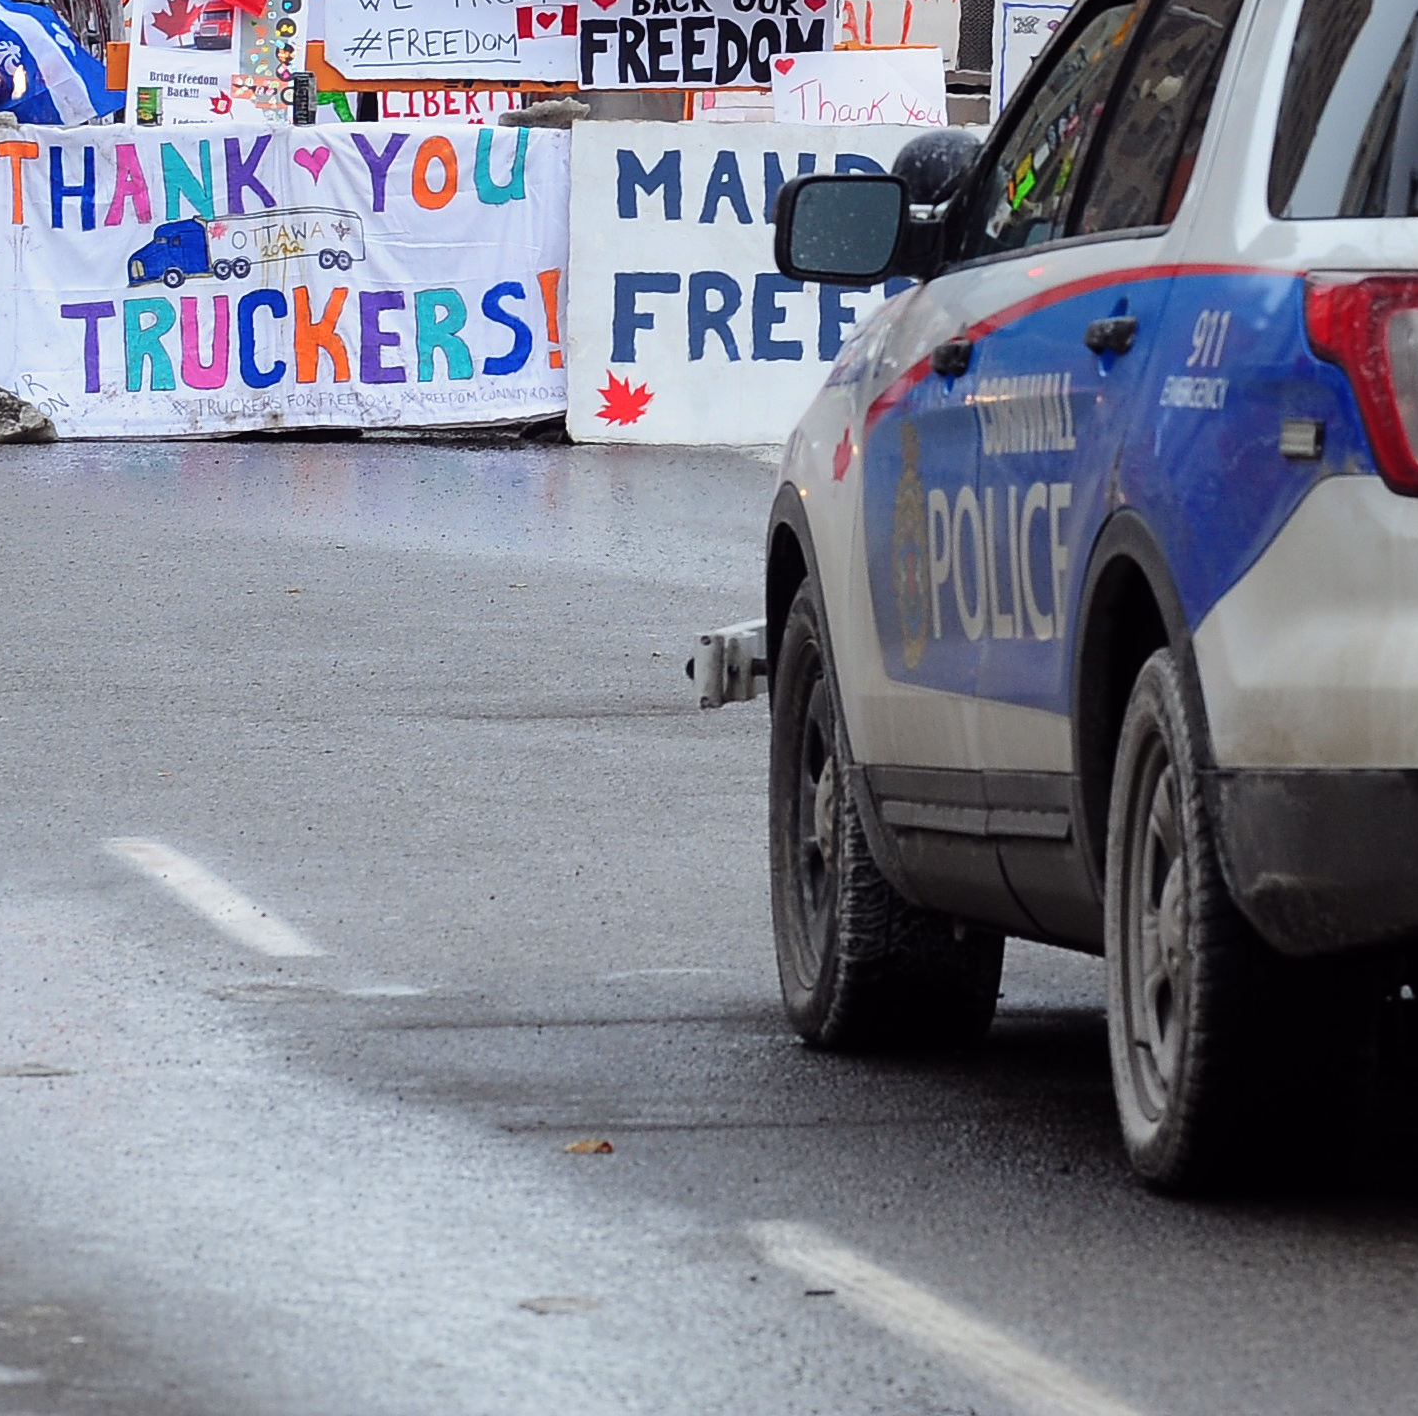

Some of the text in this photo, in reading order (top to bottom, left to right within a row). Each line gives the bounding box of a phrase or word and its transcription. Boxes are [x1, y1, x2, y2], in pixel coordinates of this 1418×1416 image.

[343, 28, 518, 60] #FREEDOM
[580, 16, 825, 85] FREEDOM
[149, 72, 175, 85] Bring
[789, 78, 944, 126] Thank You
[350, 128, 529, 213] YOU
[231, 221, 325, 249] OTTAWA
[260, 241, 306, 256] 2022
[60, 267, 565, 395] TRUCKERS!
[1186, 309, 1232, 369] 911
[194, 396, 281, 417] TRUCKERS
[287, 394, 316, 409] FOR
[927, 481, 1074, 642] POLICE
